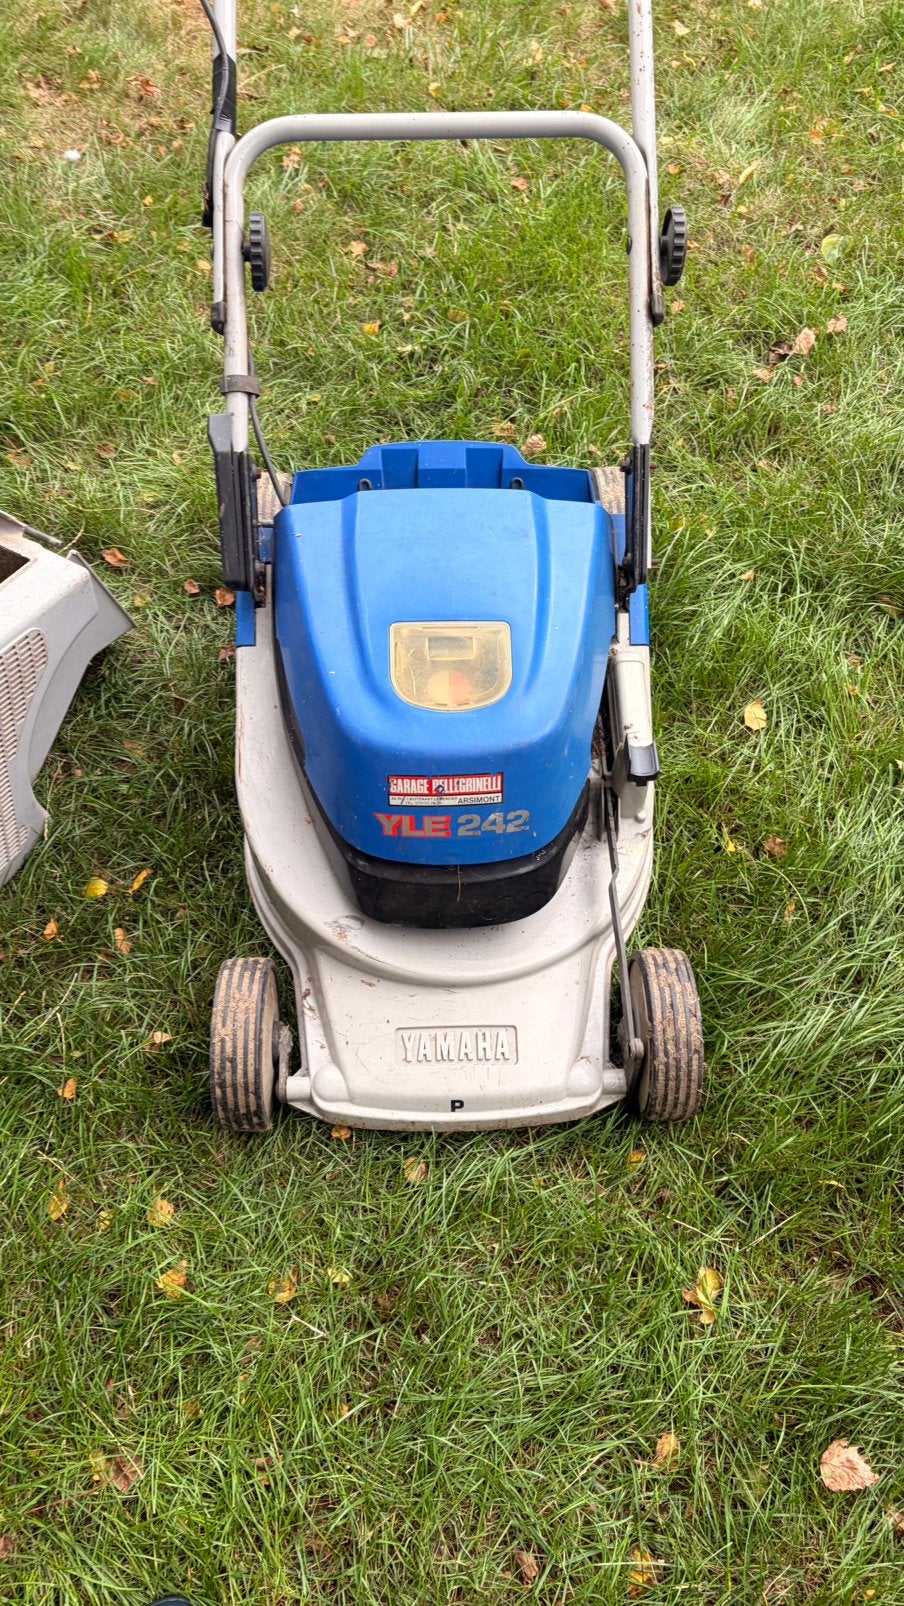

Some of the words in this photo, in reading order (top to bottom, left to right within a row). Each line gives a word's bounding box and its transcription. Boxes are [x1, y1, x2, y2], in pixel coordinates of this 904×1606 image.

[390, 778, 429, 793] GARAGE
[432, 775, 501, 793] PELLEGRINELLI
[458, 795, 500, 804] ARSIMONT
[373, 812, 452, 838] YLE
[457, 810, 530, 836] 242
[400, 1031, 511, 1062] YAMAHA
[450, 1099, 464, 1112] P
